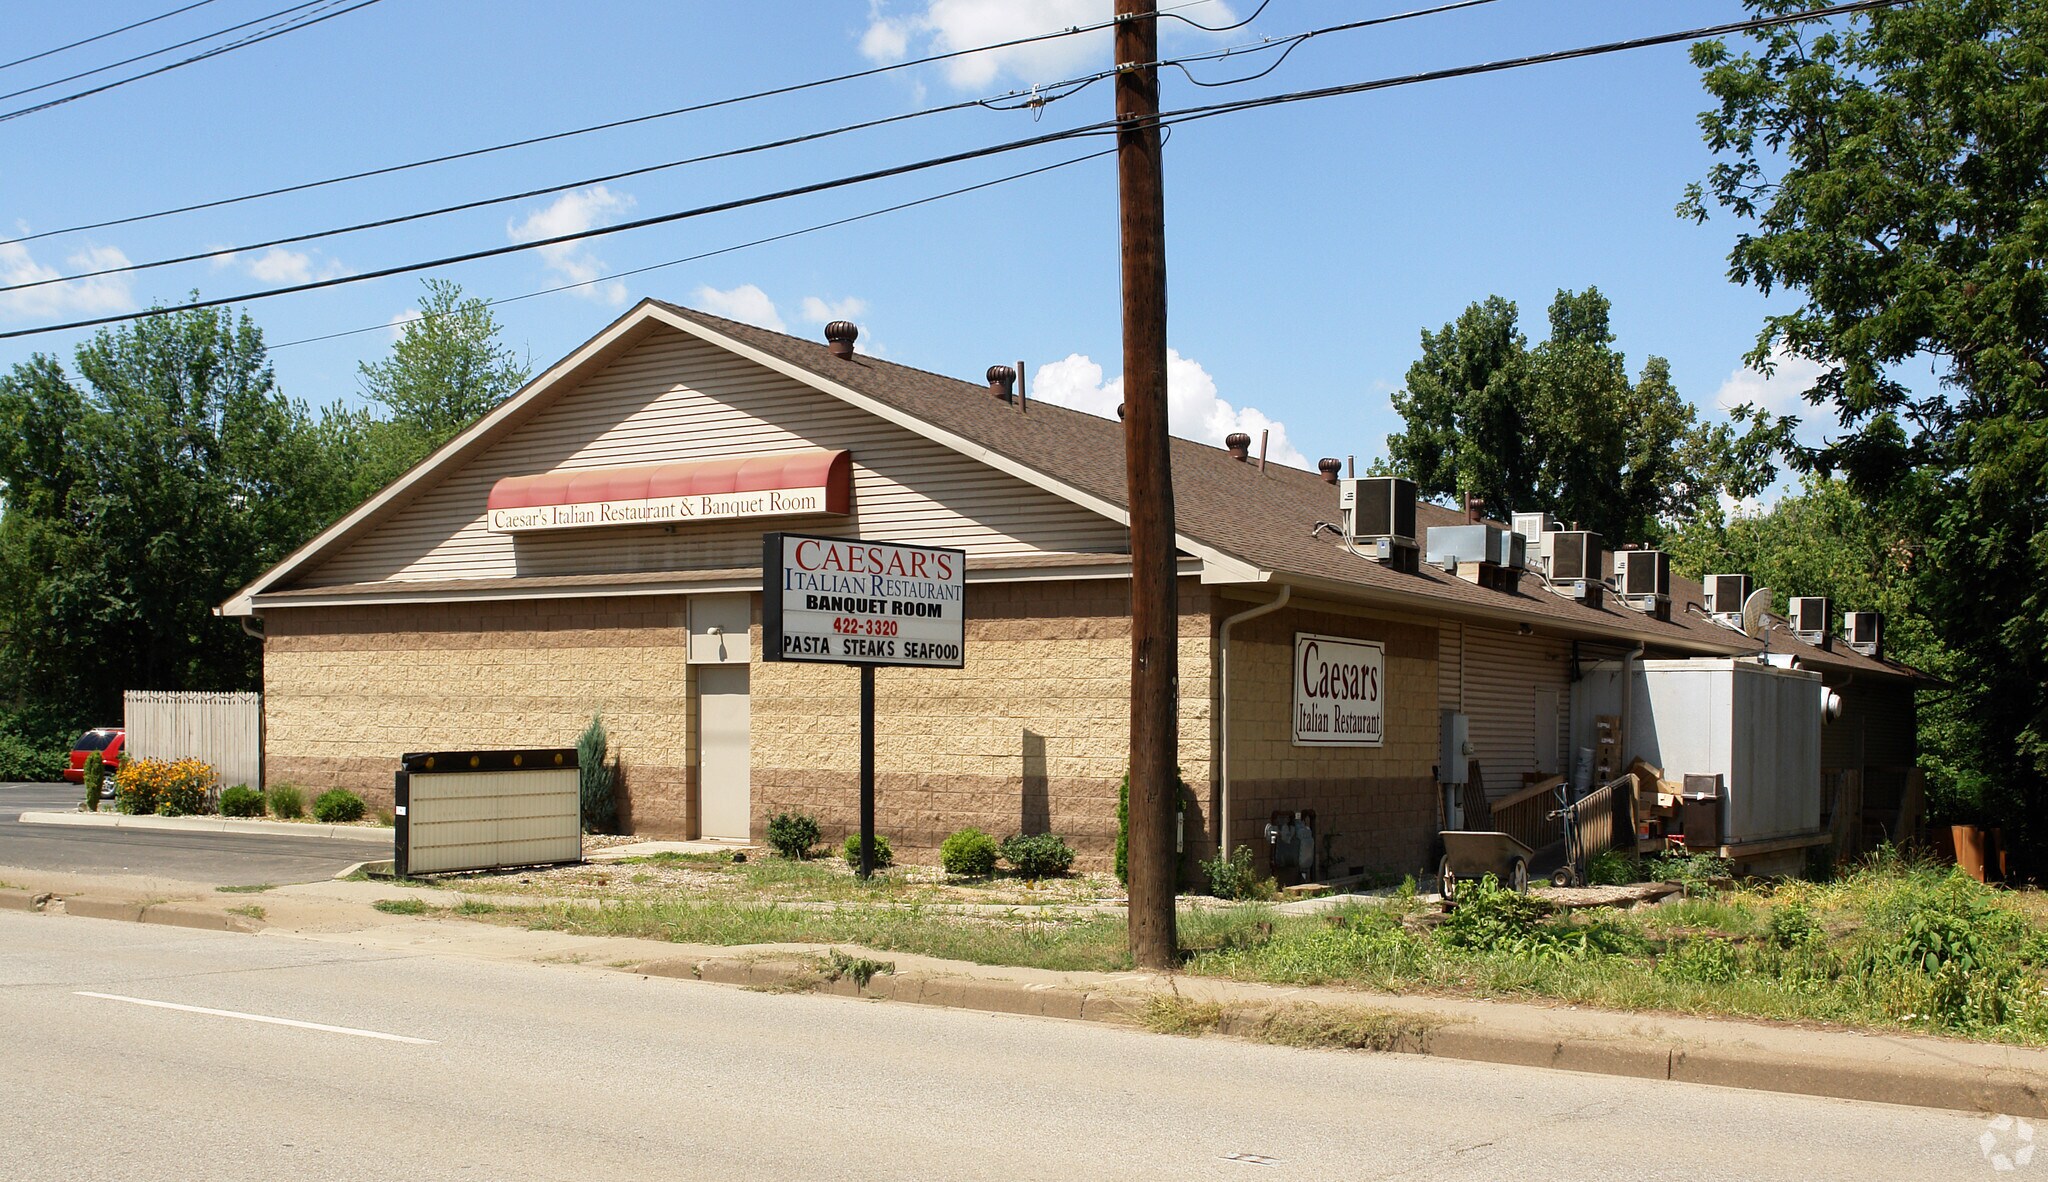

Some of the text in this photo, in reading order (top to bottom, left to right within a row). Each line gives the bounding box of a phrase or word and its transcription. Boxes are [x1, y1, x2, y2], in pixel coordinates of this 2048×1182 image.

[494, 491, 816, 530] Caesar's Italian Restaurant & Banquet Room
[795, 540, 952, 580] CAESAR'S
[784, 567, 962, 602] ITALIAN RESTAURANT
[806, 594, 942, 619] BANQUET ROOM
[833, 616, 898, 636] 422-3320
[783, 635, 959, 660] PASTA STEAKS SEAFOOD
[1299, 702, 1380, 734] Italian Restaurant
